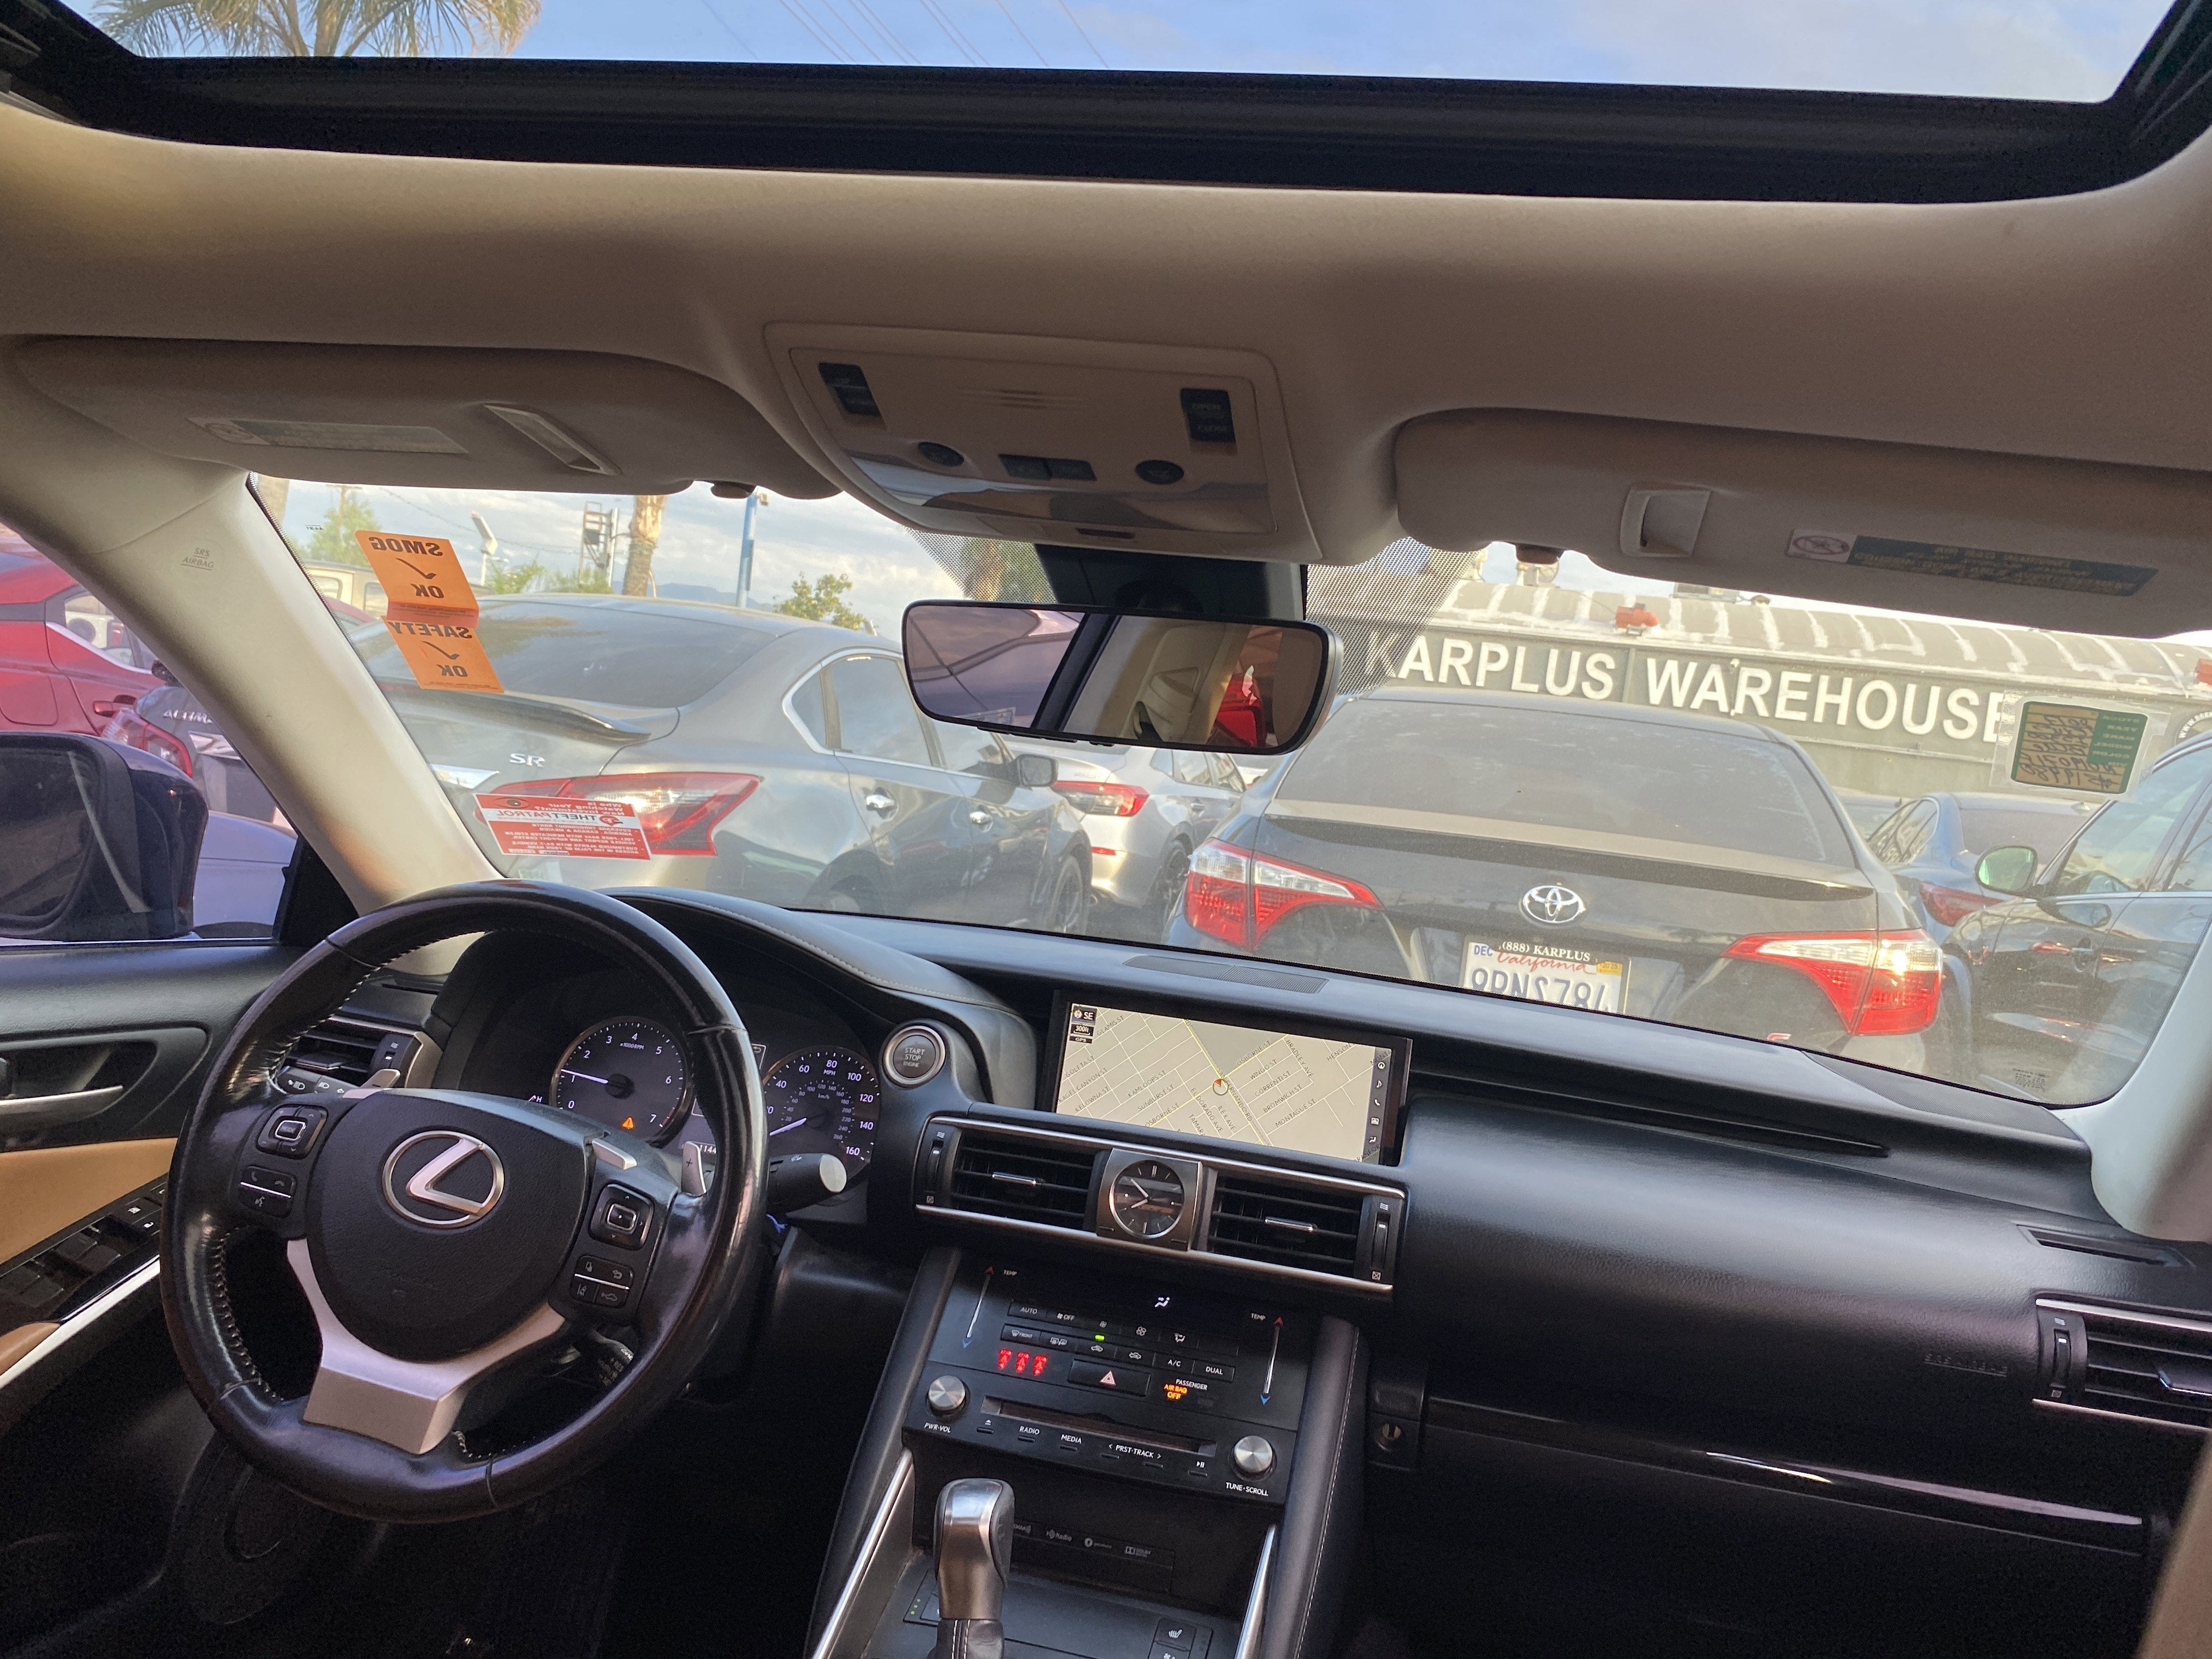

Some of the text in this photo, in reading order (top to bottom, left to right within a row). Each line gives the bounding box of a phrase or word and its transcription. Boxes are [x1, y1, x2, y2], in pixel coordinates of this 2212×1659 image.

[194, 548, 211, 557] SRS
[183, 557, 214, 568] AIRBAG
[1646, 658, 2023, 744] WAREHOUSE
[510, 753, 545, 768] SR
[1474, 941, 1590, 961] DEC (888) KARPLUS
[1497, 952, 1596, 974] California
[1083, 1012, 1094, 1020] SE
[1097, 1015, 1125, 1036] GLAMIS ST
[606, 1036, 612, 1044] 3
[583, 1050, 590, 1058] 2
[655, 1046, 663, 1055] 5
[905, 1047, 926, 1056] START
[1237, 1040, 1272, 1066] OSBORNE ST
[826, 1059, 837, 1068] 80
[1286, 1040, 1314, 1079] BRADLEY AVE
[799, 1065, 810, 1073] 60
[1065, 1056, 1096, 1077] GOLETA ST
[1250, 1059, 1278, 1080] WINGO ST
[665, 1075, 672, 1084] 6
[848, 1073, 862, 1081] 100
[776, 1080, 787, 1088] 40
[1058, 1067, 1108, 1103] KAGEL CANYON ST
[1127, 1070, 1167, 1098] KAMLOOPS ST
[1254, 1070, 1291, 1097] CORRENTI ST
[860, 1093, 874, 1103] 120
[1075, 1086, 1110, 1113] KELOWNA ST
[1137, 1084, 1175, 1111] SUNBURST ST
[1263, 1084, 1302, 1113] BROMWICH ST
[568, 1101, 574, 1109] 0
[1190, 1087, 1223, 1133] EL DORADO AVE
[1145, 1103, 1180, 1127] OSBORNE ST
[1217, 1105, 1237, 1130] ILEX AVE
[1245, 1112, 1253, 1122] RD
[1275, 1098, 1317, 1128] MONTAGUE ST
[650, 1114, 657, 1123] 7
[860, 1121, 874, 1130] 140
[846, 1146, 860, 1155] 160
[1251, 1312, 1266, 1321] TEMP
[1167, 1359, 1181, 1367] A/C
[1205, 1365, 1223, 1375] DUAL
[1164, 1384, 1188, 1394] AIR BAG
[1176, 1378, 1207, 1391] PASSENGER
[1167, 1391, 1182, 1400] OFF
[1019, 1425, 1040, 1435] RADIO
[1060, 1434, 1082, 1444] MEDIA
